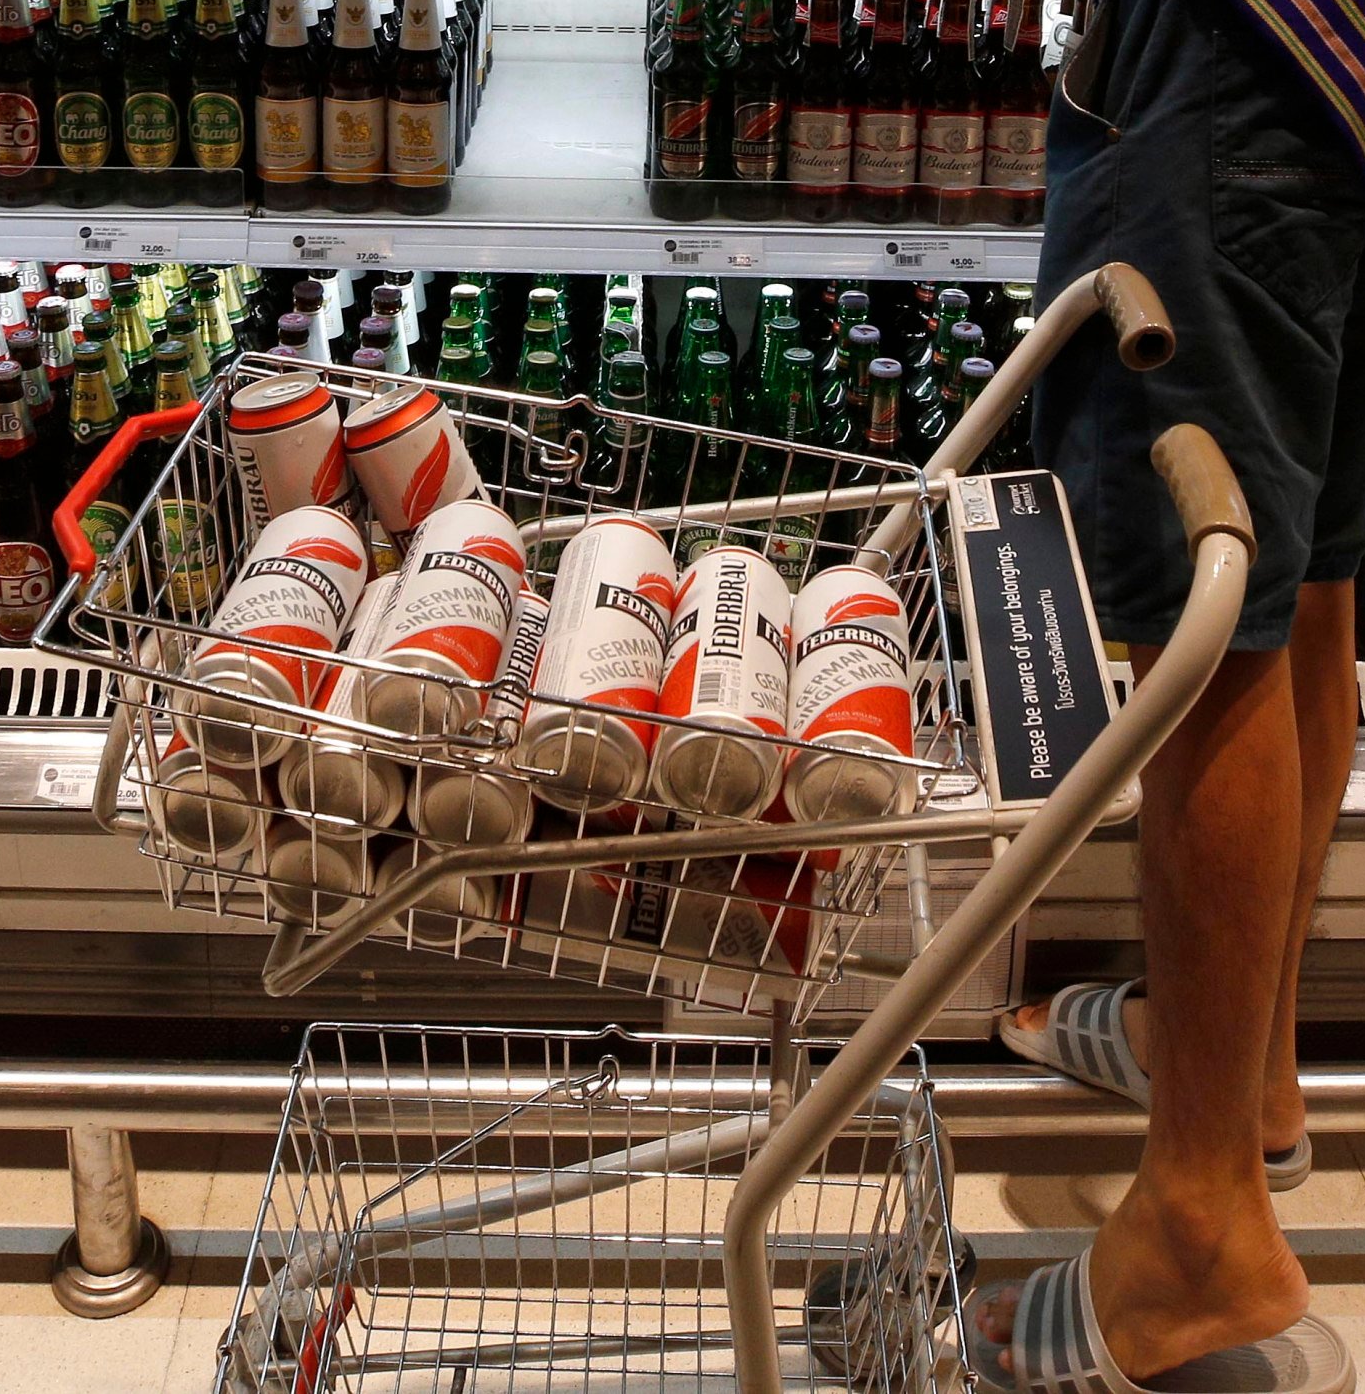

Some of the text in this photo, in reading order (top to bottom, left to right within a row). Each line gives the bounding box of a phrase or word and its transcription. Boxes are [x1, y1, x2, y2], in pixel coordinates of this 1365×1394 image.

[356, 253, 379, 261] 37.00
[950, 258, 973, 266] 45.00
[248, 557, 347, 618] FEDERBRÄU
[405, 586, 487, 615] GERMAN
[703, 556, 748, 659] FEDERBRÄU
[802, 626, 904, 665] FEDERBRÄU
[996, 542, 1053, 779] Please be aware of your belongings.
